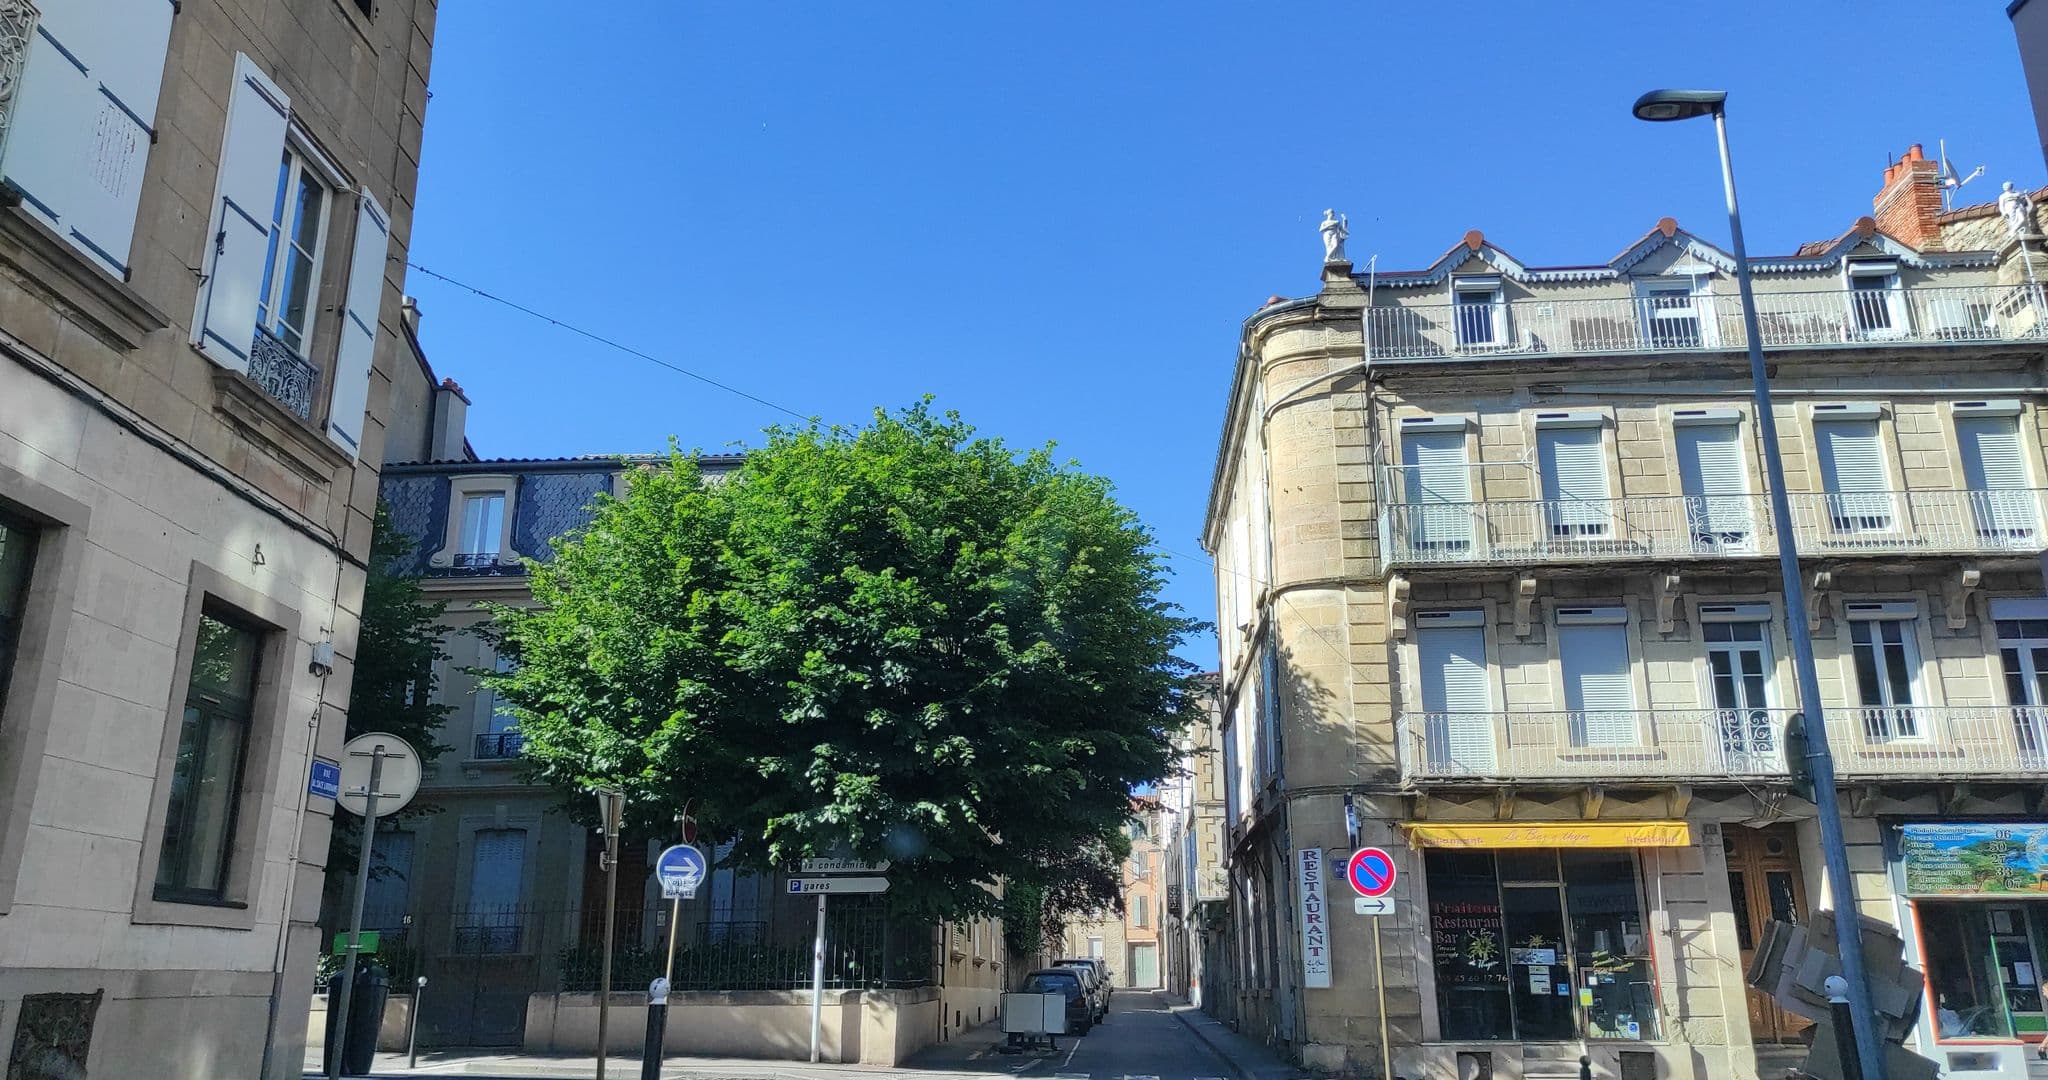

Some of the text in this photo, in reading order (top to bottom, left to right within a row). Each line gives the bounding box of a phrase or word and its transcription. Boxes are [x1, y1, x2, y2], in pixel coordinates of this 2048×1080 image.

[1995, 829, 2012, 840] 06
[803, 881, 830, 890] gares
[1303, 850, 1324, 957] RESTAURANT
[1432, 902, 1500, 914] Traiteur
[403, 915, 412, 924] 16
[1434, 930, 1459, 944] Bar
[1496, 974, 1508, 982] 76
